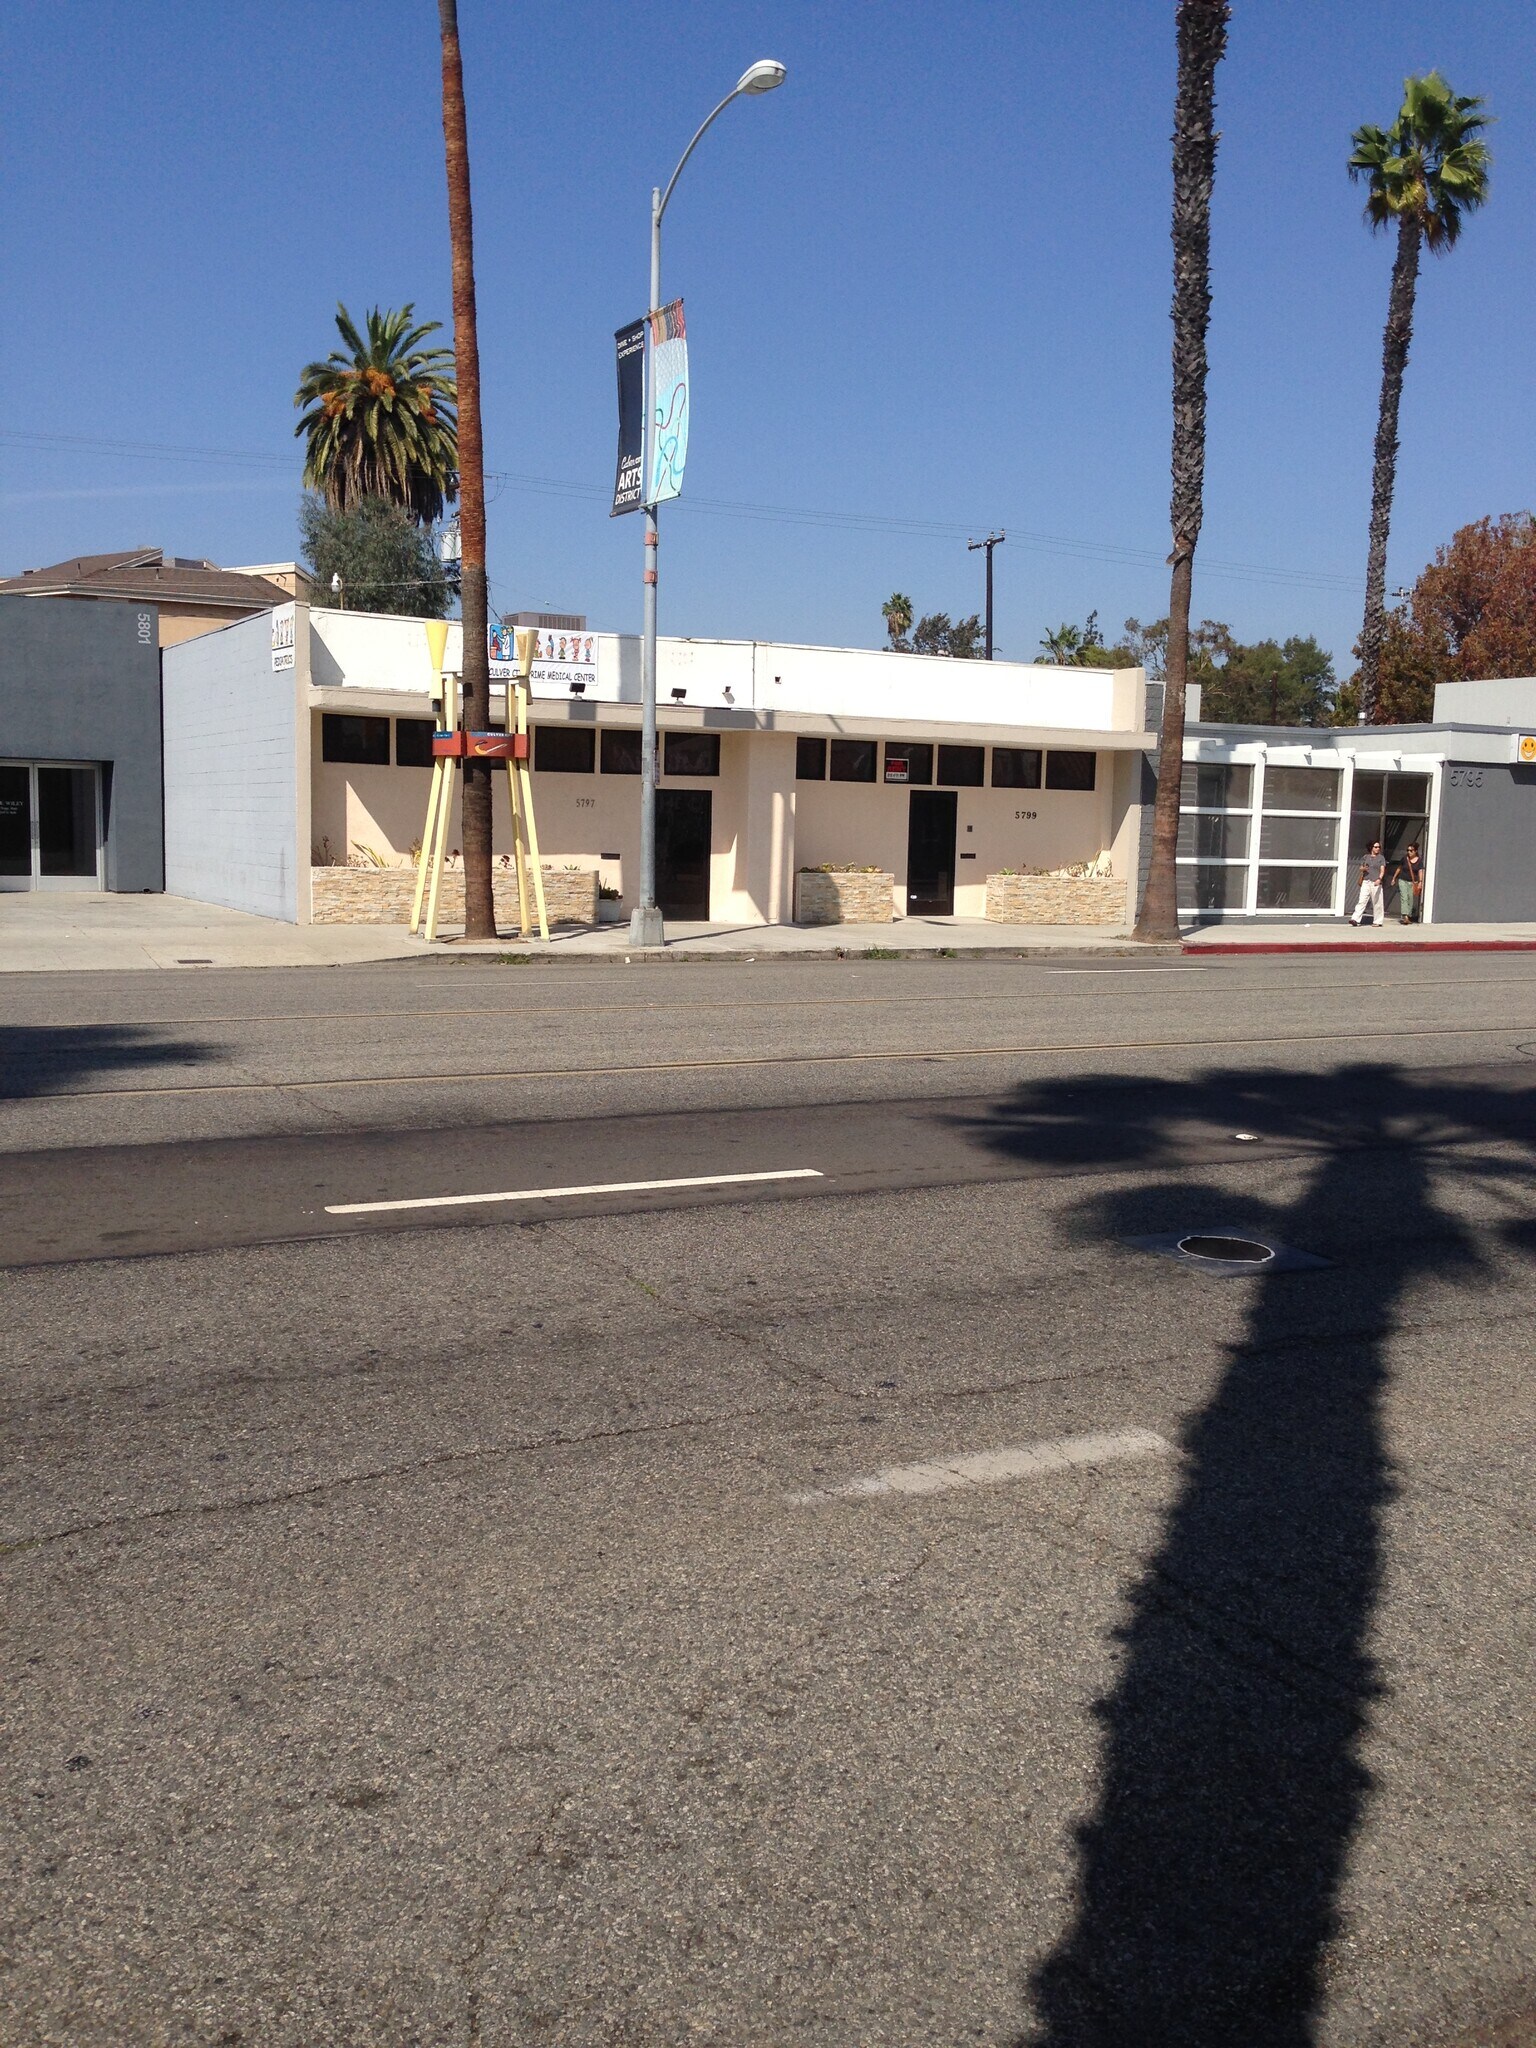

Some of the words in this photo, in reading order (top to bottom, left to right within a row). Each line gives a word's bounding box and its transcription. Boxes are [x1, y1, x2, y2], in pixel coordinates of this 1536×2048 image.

[631, 331, 644, 342] SHOP
[618, 341, 644, 359] EXPERIENCE
[617, 467, 642, 492] ARTS
[614, 488, 642, 506] DISTRICT
[137, 613, 152, 645] 5801
[547, 670, 573, 682] MEDICAL
[573, 672, 596, 683] CENTER
[1450, 770, 1484, 788] 5795
[576, 798, 595, 808] 5797
[1014, 811, 1037, 820] 5799
